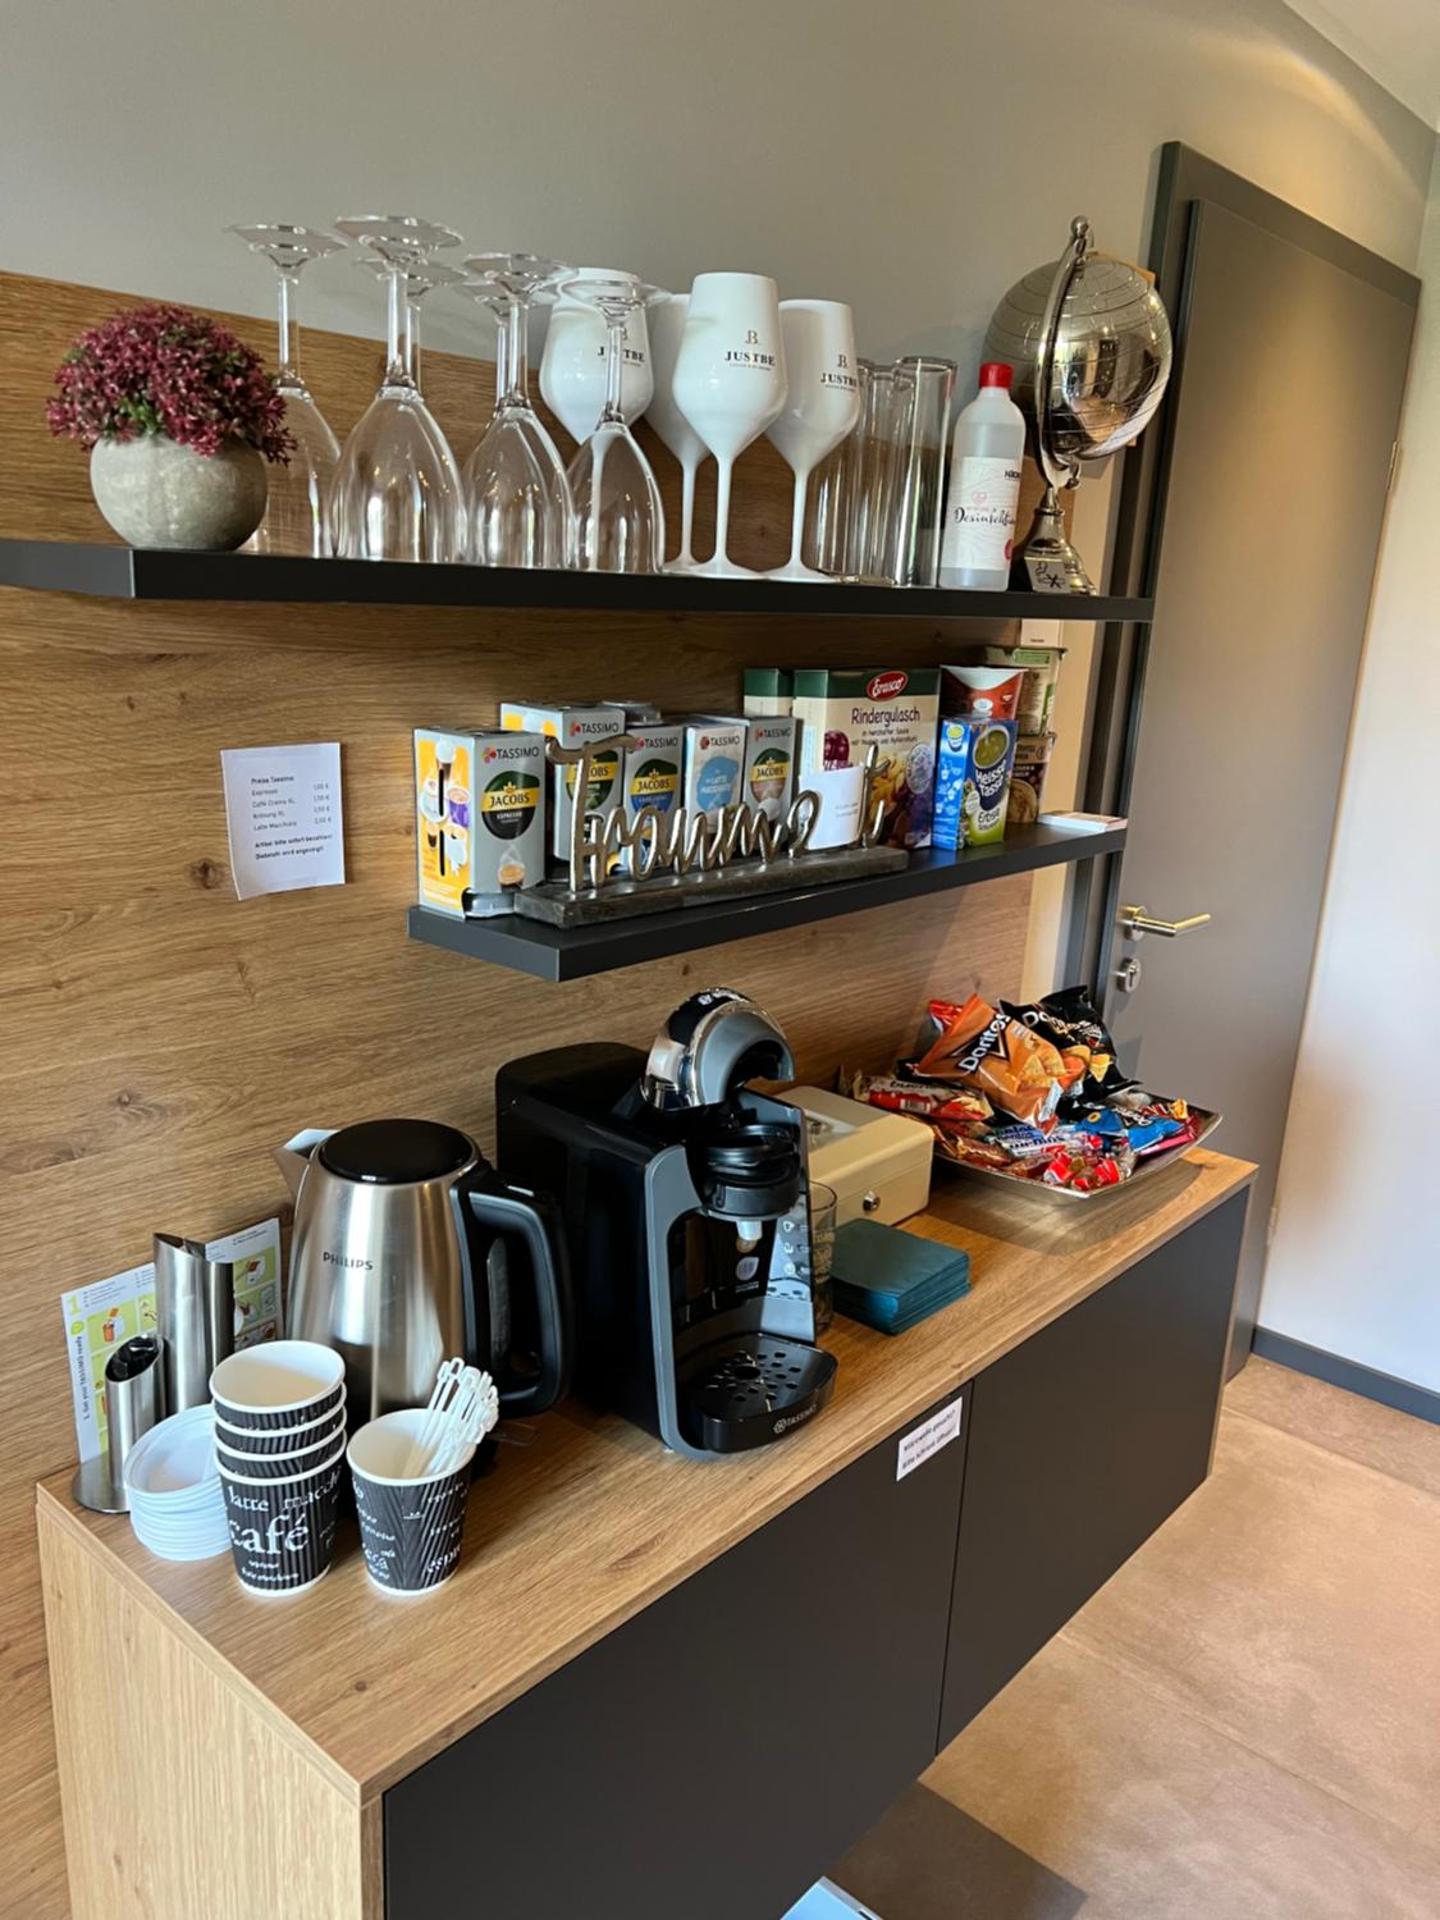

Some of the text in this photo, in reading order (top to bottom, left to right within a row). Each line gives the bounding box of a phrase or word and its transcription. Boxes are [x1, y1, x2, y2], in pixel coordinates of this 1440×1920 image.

[598, 346, 645, 362] JTBE
[725, 351, 775, 366] JUSTBE
[851, 706, 921, 727] Rindergulasch
[582, 722, 619, 734] TASSIMO
[645, 737, 679, 748] TASSIMO
[710, 735, 741, 747] TASSIMO
[496, 745, 540, 760] TASSIMO
[636, 779, 671, 792] JACOBS
[489, 793, 531, 809] JACOBS
[323, 1251, 373, 1271] PHILIPS
[228, 1485, 269, 1512] latte
[228, 1512, 309, 1555] café
